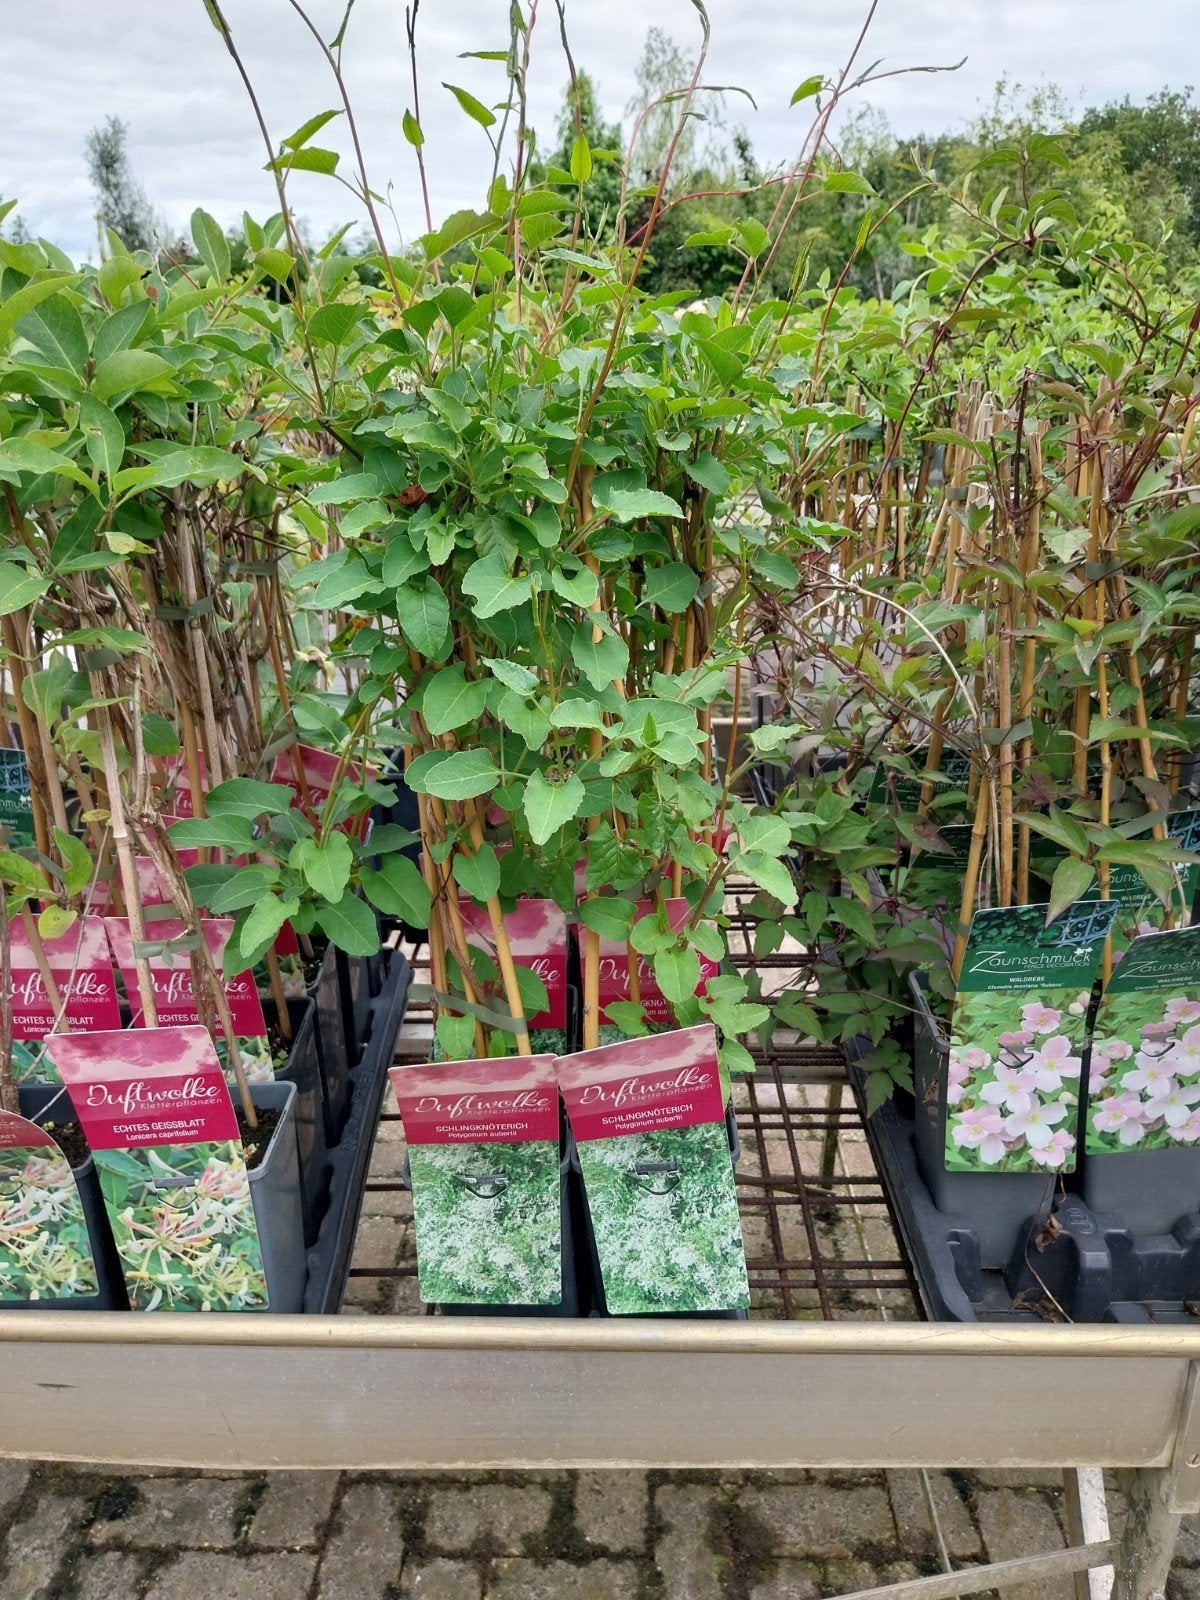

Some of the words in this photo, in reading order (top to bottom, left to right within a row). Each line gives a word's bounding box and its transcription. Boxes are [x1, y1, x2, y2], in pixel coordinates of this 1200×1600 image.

[969, 950, 1091, 973] Zaunschmuck
[12, 1016, 46, 1025] ECHTES
[157, 1013, 189, 1022] ECHTES
[580, 1066, 713, 1107] Duftwolke
[86, 1076, 222, 1114] Duftwolke
[140, 1097, 223, 1110] Kletterpflanzen
[414, 1090, 552, 1119] Duftwolke
[602, 1103, 693, 1125] SCHLINGKNÖTERICH
[113, 1123, 150, 1134] ECHTES
[151, 1118, 206, 1131] GEISSBLATT
[435, 1122, 529, 1133] SCHLINGKNÖTERICH
[614, 1119, 655, 1130] Polygonum
[126, 1132, 158, 1141] Lonicera
[158, 1129, 199, 1140] caprifolium
[448, 1131, 489, 1139] Polygonum
